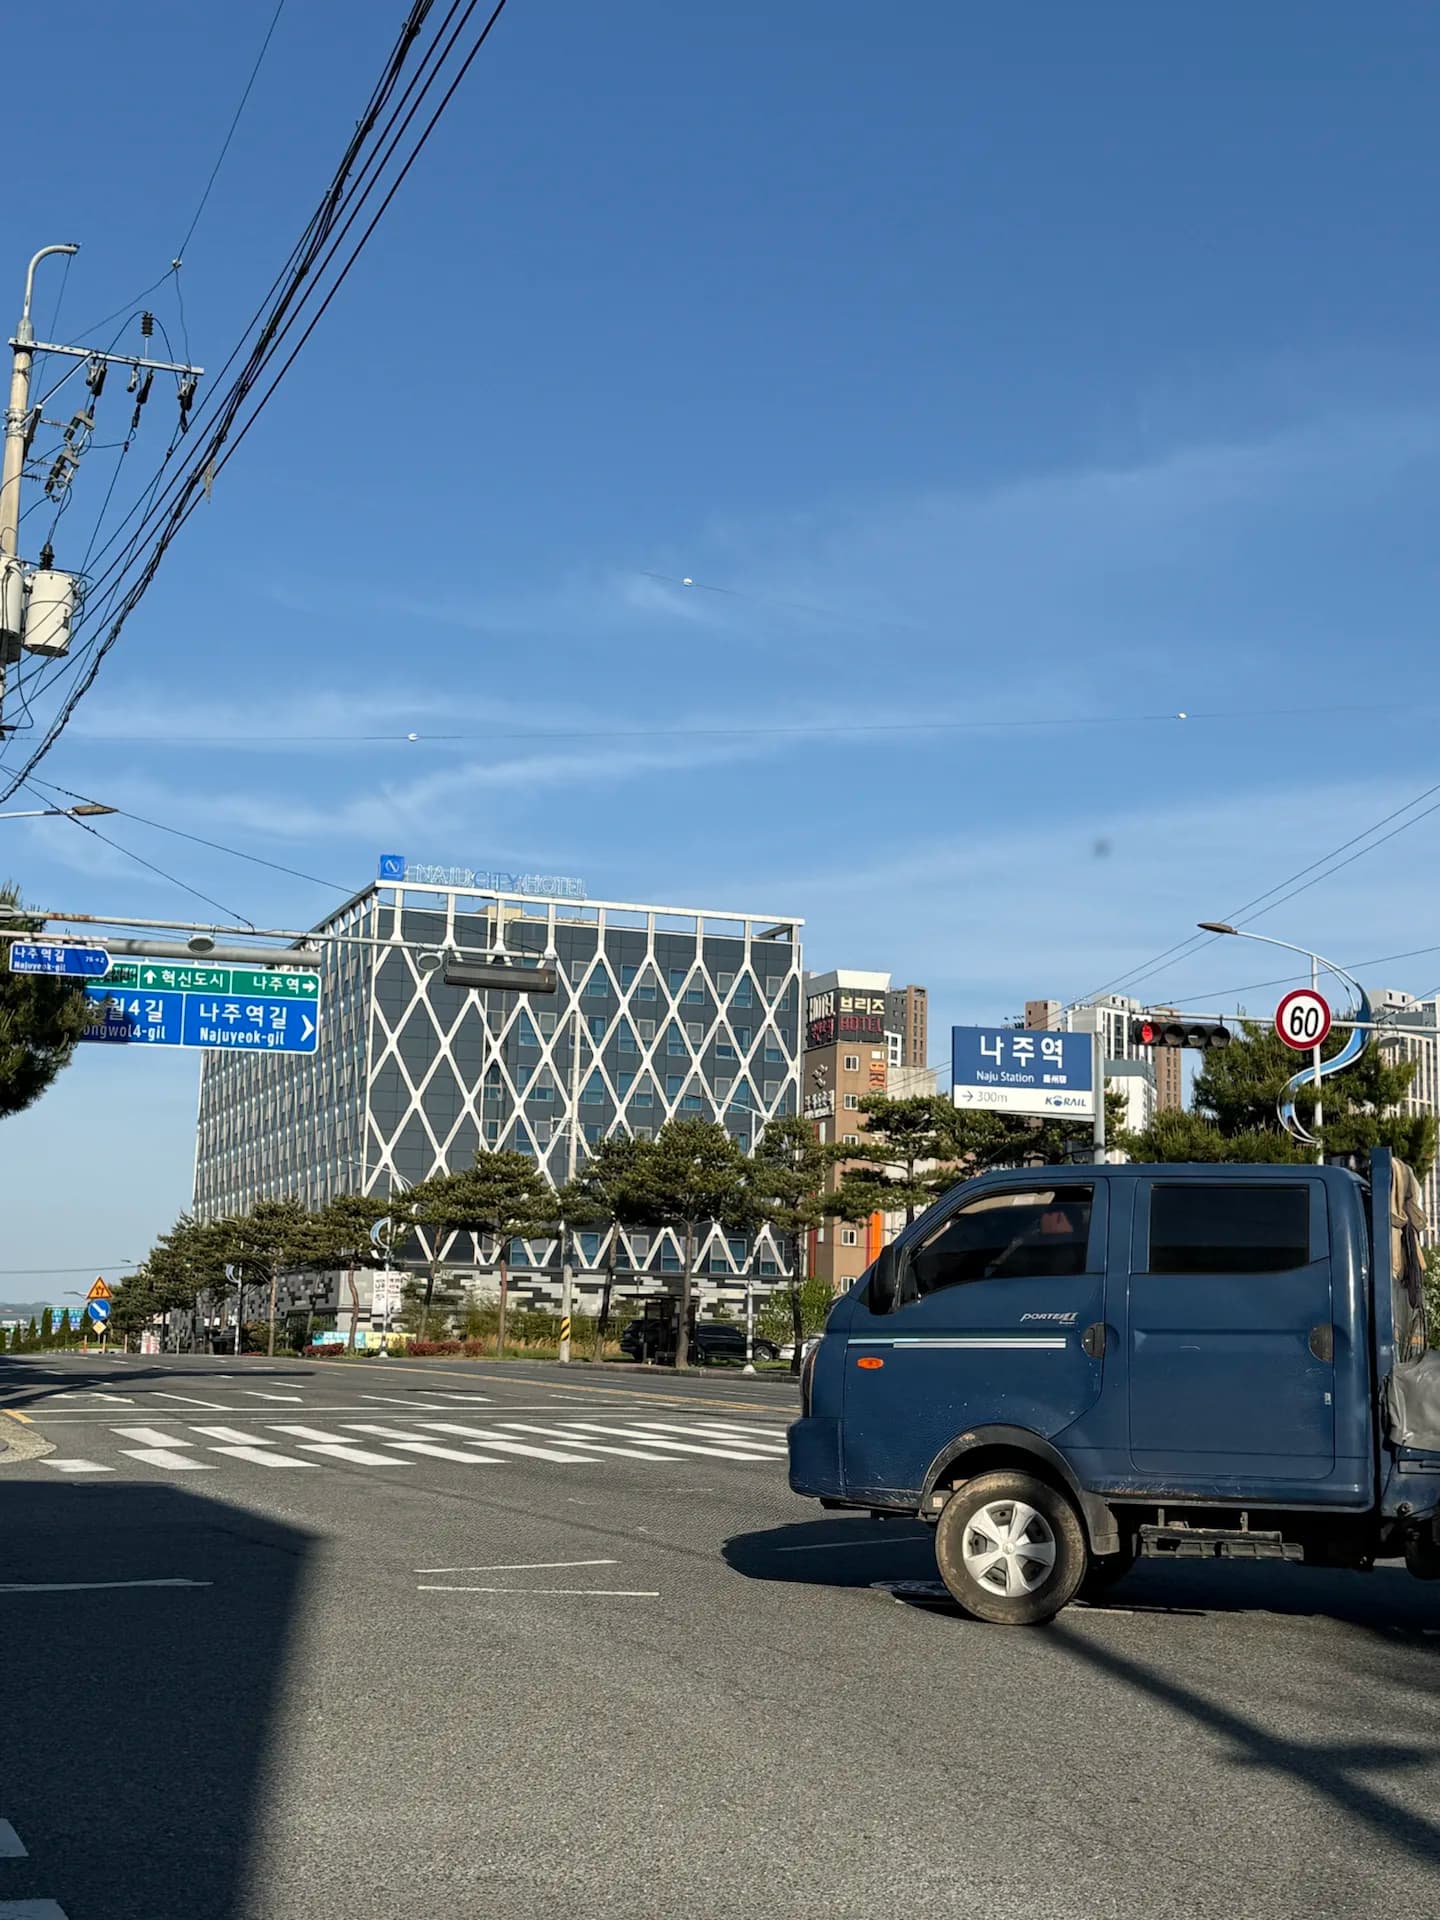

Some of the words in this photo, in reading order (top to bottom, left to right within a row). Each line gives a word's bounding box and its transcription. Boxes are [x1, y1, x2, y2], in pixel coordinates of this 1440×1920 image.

[474, 870, 520, 891] CITY
[522, 874, 587, 899] HOTEL
[14, 946, 65, 963] 나주역길
[13, 961, 66, 972] Najuyeok-gil
[161, 970, 224, 988] 혁신도시
[253, 976, 299, 995] 나주역
[839, 996, 886, 1016] 브리즈
[199, 1003, 288, 1030] 나주역길
[839, 1015, 882, 1033] HOTEL
[1290, 1006, 1319, 1038] 60
[83, 1023, 166, 1042] ongwol4-gil
[200, 1027, 285, 1047] Najuyeok-gil
[980, 1035, 1064, 1069] 나주역
[976, 1070, 999, 1084] Naju
[1000, 1071, 1035, 1084] Station
[977, 1091, 1008, 1104] 300m
[1045, 1095, 1087, 1107] KORAIL
